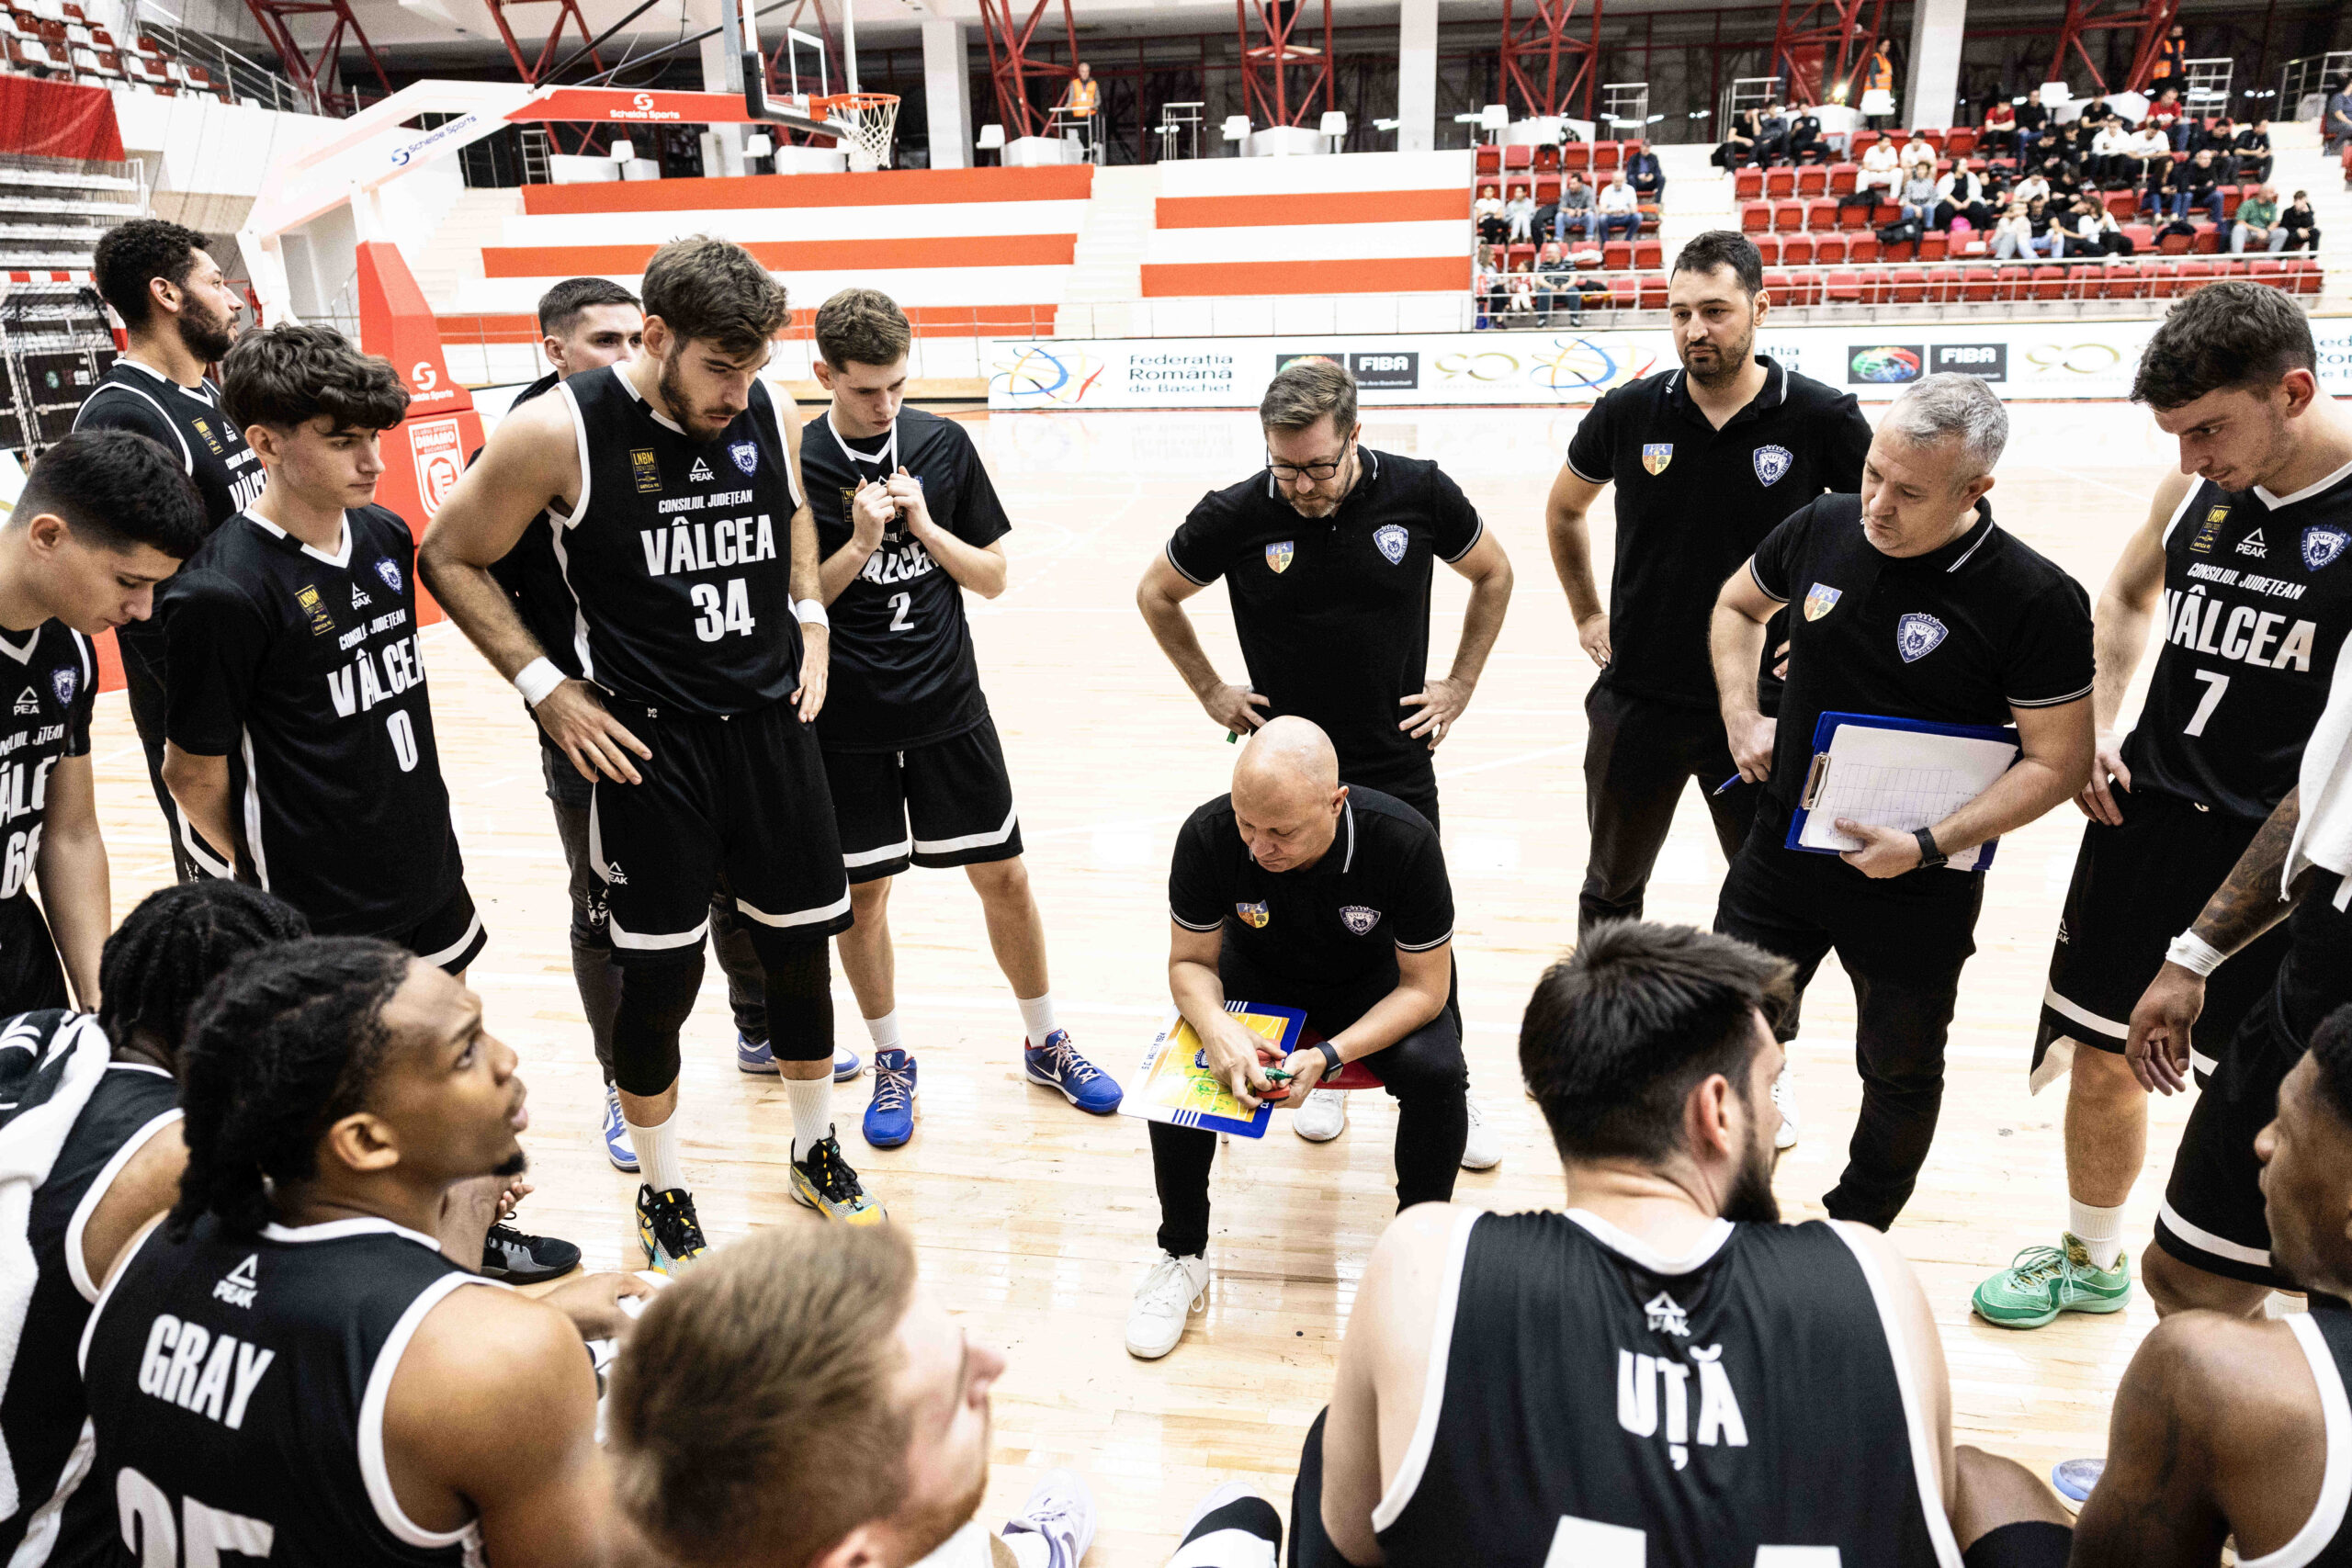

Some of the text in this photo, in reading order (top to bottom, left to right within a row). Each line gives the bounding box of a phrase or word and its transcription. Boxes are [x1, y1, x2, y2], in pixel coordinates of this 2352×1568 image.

[649, 109, 680, 120] Sports
[447, 116, 477, 133] Sports
[1359, 355, 1408, 371] FIBA
[1939, 346, 1996, 364] FIBA
[1130, 367, 1233, 379] Română
[1129, 383, 1231, 392] de Baschet
[415, 431, 456, 449] DINAMO
[633, 451, 654, 466] LNBM
[689, 471, 715, 482] PEAK
[659, 489, 752, 513] CONSILIUL JUDEȚEAN
[640, 514, 776, 577] VÂLCEA
[2235, 543, 2268, 558] PEAK
[2187, 562, 2307, 600] CONSILIUL JUDEȚEAN
[351, 594, 372, 610] PAK
[690, 578, 755, 642] 34
[888, 592, 914, 631] 2
[2165, 583, 2317, 671] VÂLCEA
[14, 705, 40, 716] PEA
[2183, 669, 2231, 737] 7
[386, 709, 419, 773] 0
[609, 874, 628, 886] EAK
[212, 1280, 258, 1309] PEAK
[139, 1314, 276, 1430] GRAY
[1617, 1343, 1748, 1471] UȚĂ
